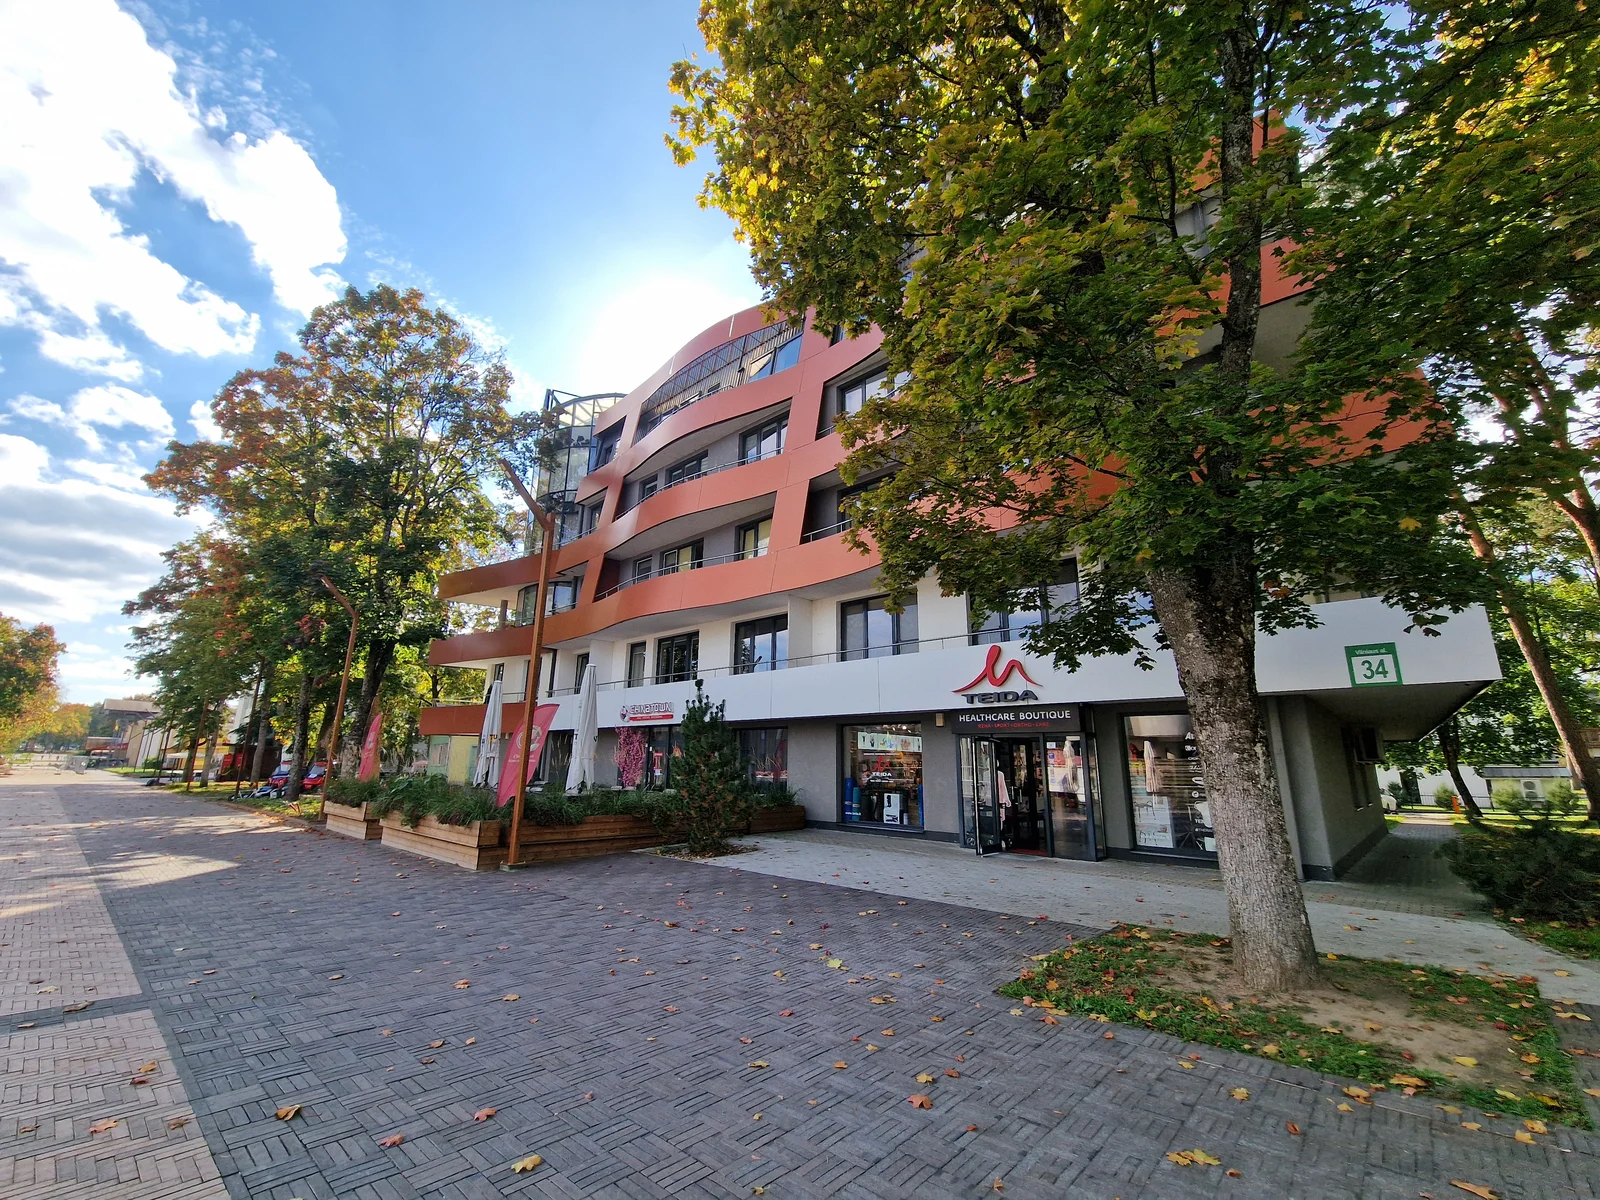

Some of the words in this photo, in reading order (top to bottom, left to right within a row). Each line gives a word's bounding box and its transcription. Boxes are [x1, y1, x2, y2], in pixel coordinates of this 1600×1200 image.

[1361, 658, 1389, 680] 34
[961, 689, 1039, 705] TEIDA
[959, 712, 1016, 722] HEALTHCARE
[1019, 710, 1071, 720] BOUTIQUE
